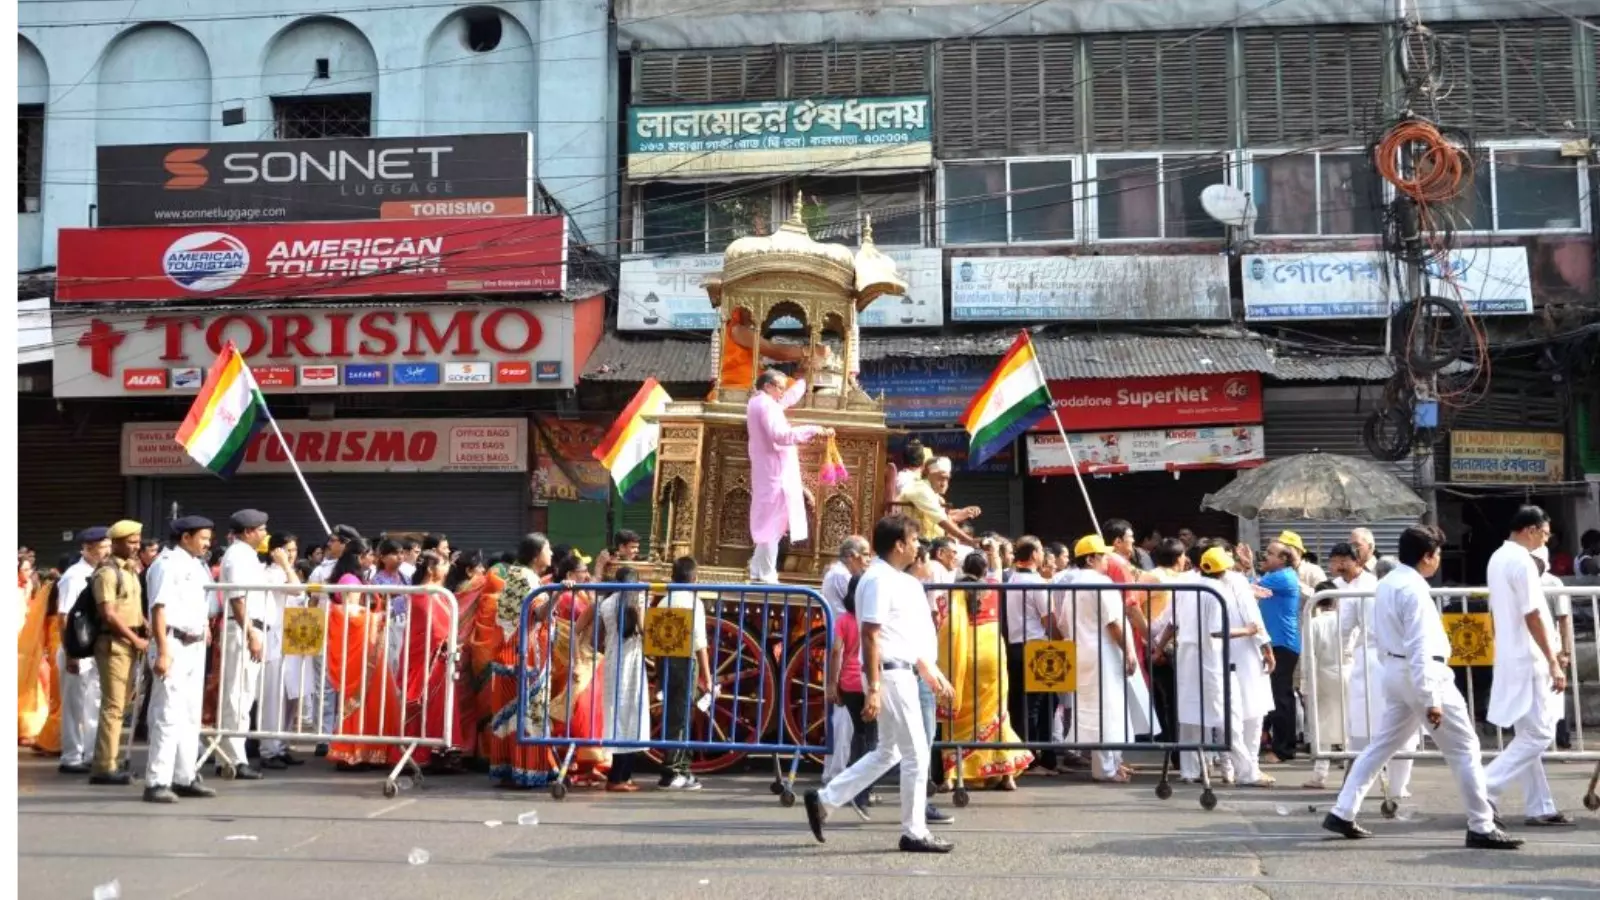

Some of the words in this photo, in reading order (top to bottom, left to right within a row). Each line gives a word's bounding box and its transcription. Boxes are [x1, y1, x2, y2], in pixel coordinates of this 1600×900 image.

[636, 106, 787, 138] লালমোহন
[793, 99, 927, 132] ঔষধালয়
[223, 146, 453, 184] SONNET
[340, 181, 453, 196] LUGGAGE
[154, 206, 286, 221] www.sonnetluggage.com
[411, 201, 494, 217] TORISMO
[266, 236, 443, 259] AMERICAN
[168, 251, 243, 262] AMERICAN
[168, 260, 244, 270] TOURISTER
[144, 307, 543, 361] TORISMO
[1055, 396, 1112, 407] vodafone
[1117, 386, 1209, 406] SuperNet
[928, 410, 962, 418] Kolkat
[456, 430, 484, 438] OFFICE
[486, 430, 510, 438] BAGS
[1165, 429, 1198, 441] Kinder
[246, 430, 437, 463] TORISMO
[460, 442, 479, 450] KIDS
[482, 442, 505, 450] BAGS
[456, 454, 485, 463] LADIES
[487, 454, 510, 463] BAGS
